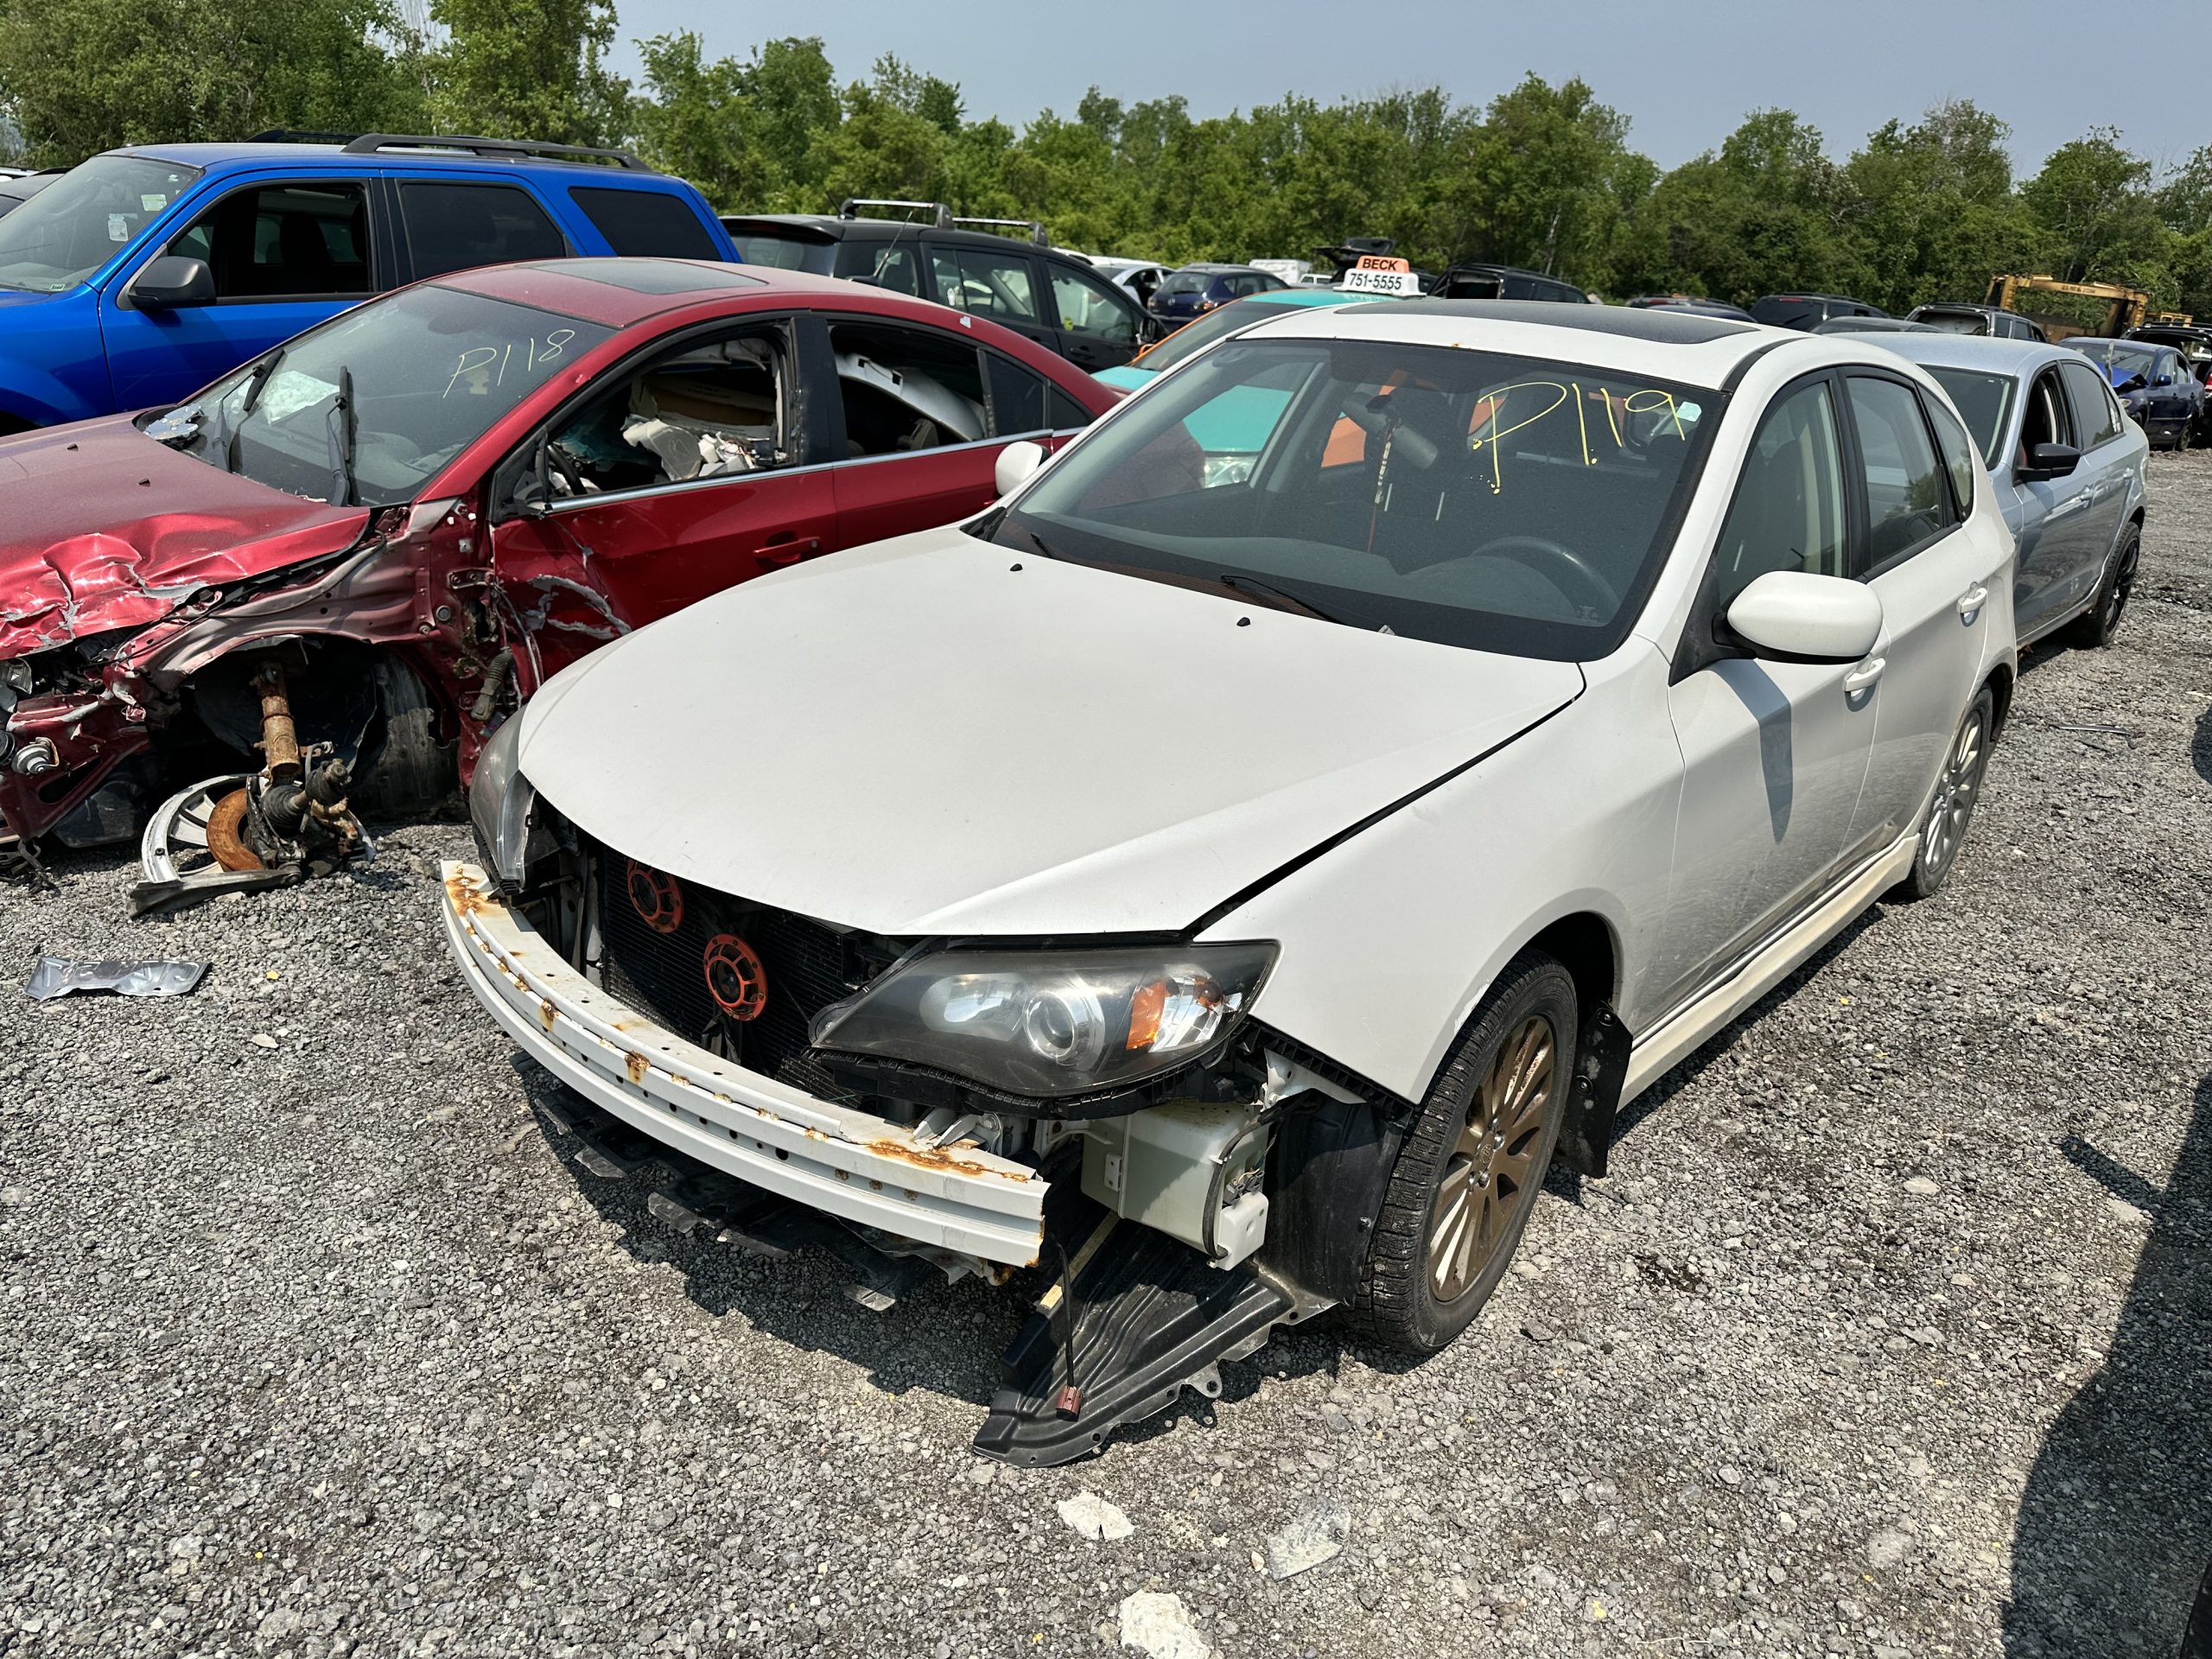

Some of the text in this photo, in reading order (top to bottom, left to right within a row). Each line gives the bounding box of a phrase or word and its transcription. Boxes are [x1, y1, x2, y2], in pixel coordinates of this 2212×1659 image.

[1349, 273, 1403, 290] 751-5555
[1362, 258, 1398, 271] BECK
[442, 329, 575, 399] P118
[1474, 381, 1685, 490] P119
